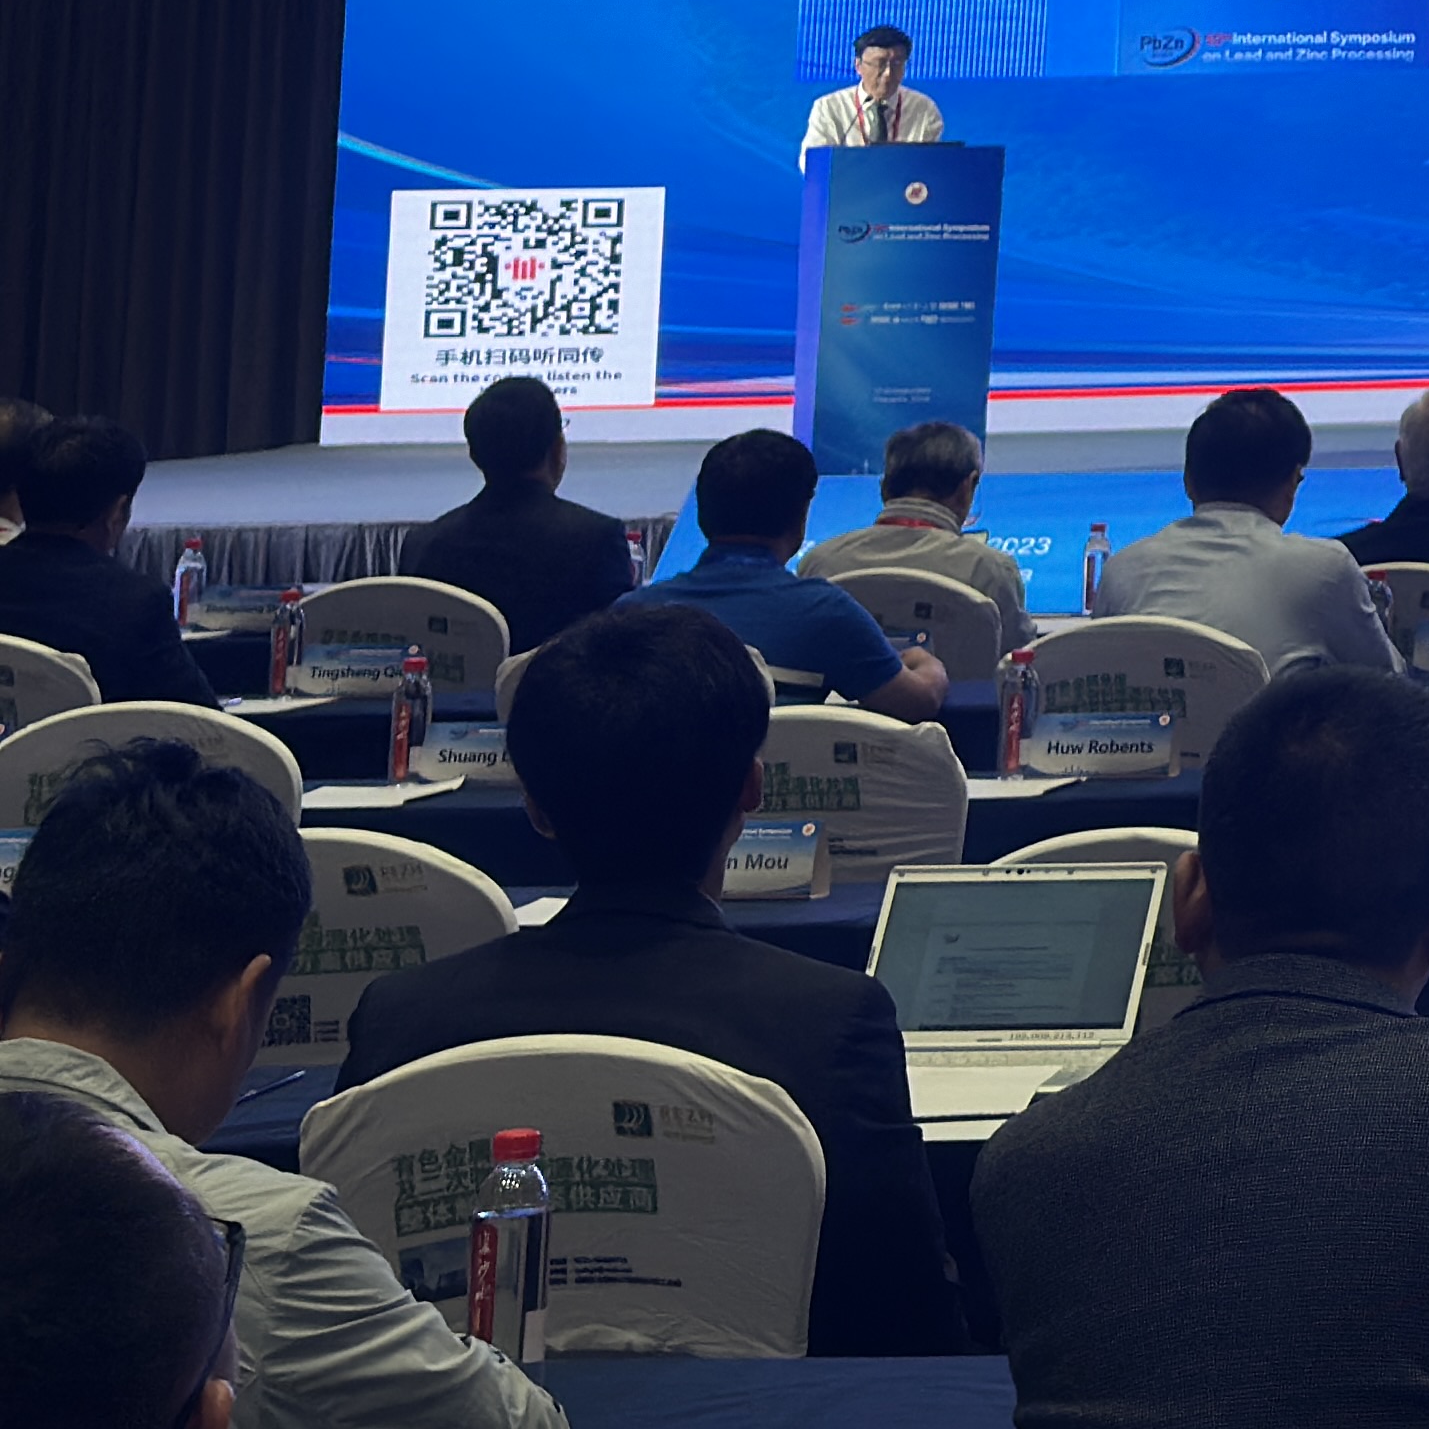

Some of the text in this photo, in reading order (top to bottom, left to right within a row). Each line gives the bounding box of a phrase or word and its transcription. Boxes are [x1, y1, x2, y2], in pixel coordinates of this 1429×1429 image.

[1232, 30, 1327, 46] International
[1330, 30, 1416, 47] Symposium
[435, 346, 604, 366] 手机扫码听同传
[410, 372, 449, 384] Scan
[453, 371, 480, 383] the
[546, 371, 593, 381] listen
[596, 370, 622, 381] the
[310, 666, 380, 681] Tingsheng
[1047, 740, 1084, 755] Huw
[438, 748, 497, 767] Shuang
[745, 853, 789, 870] Mou
